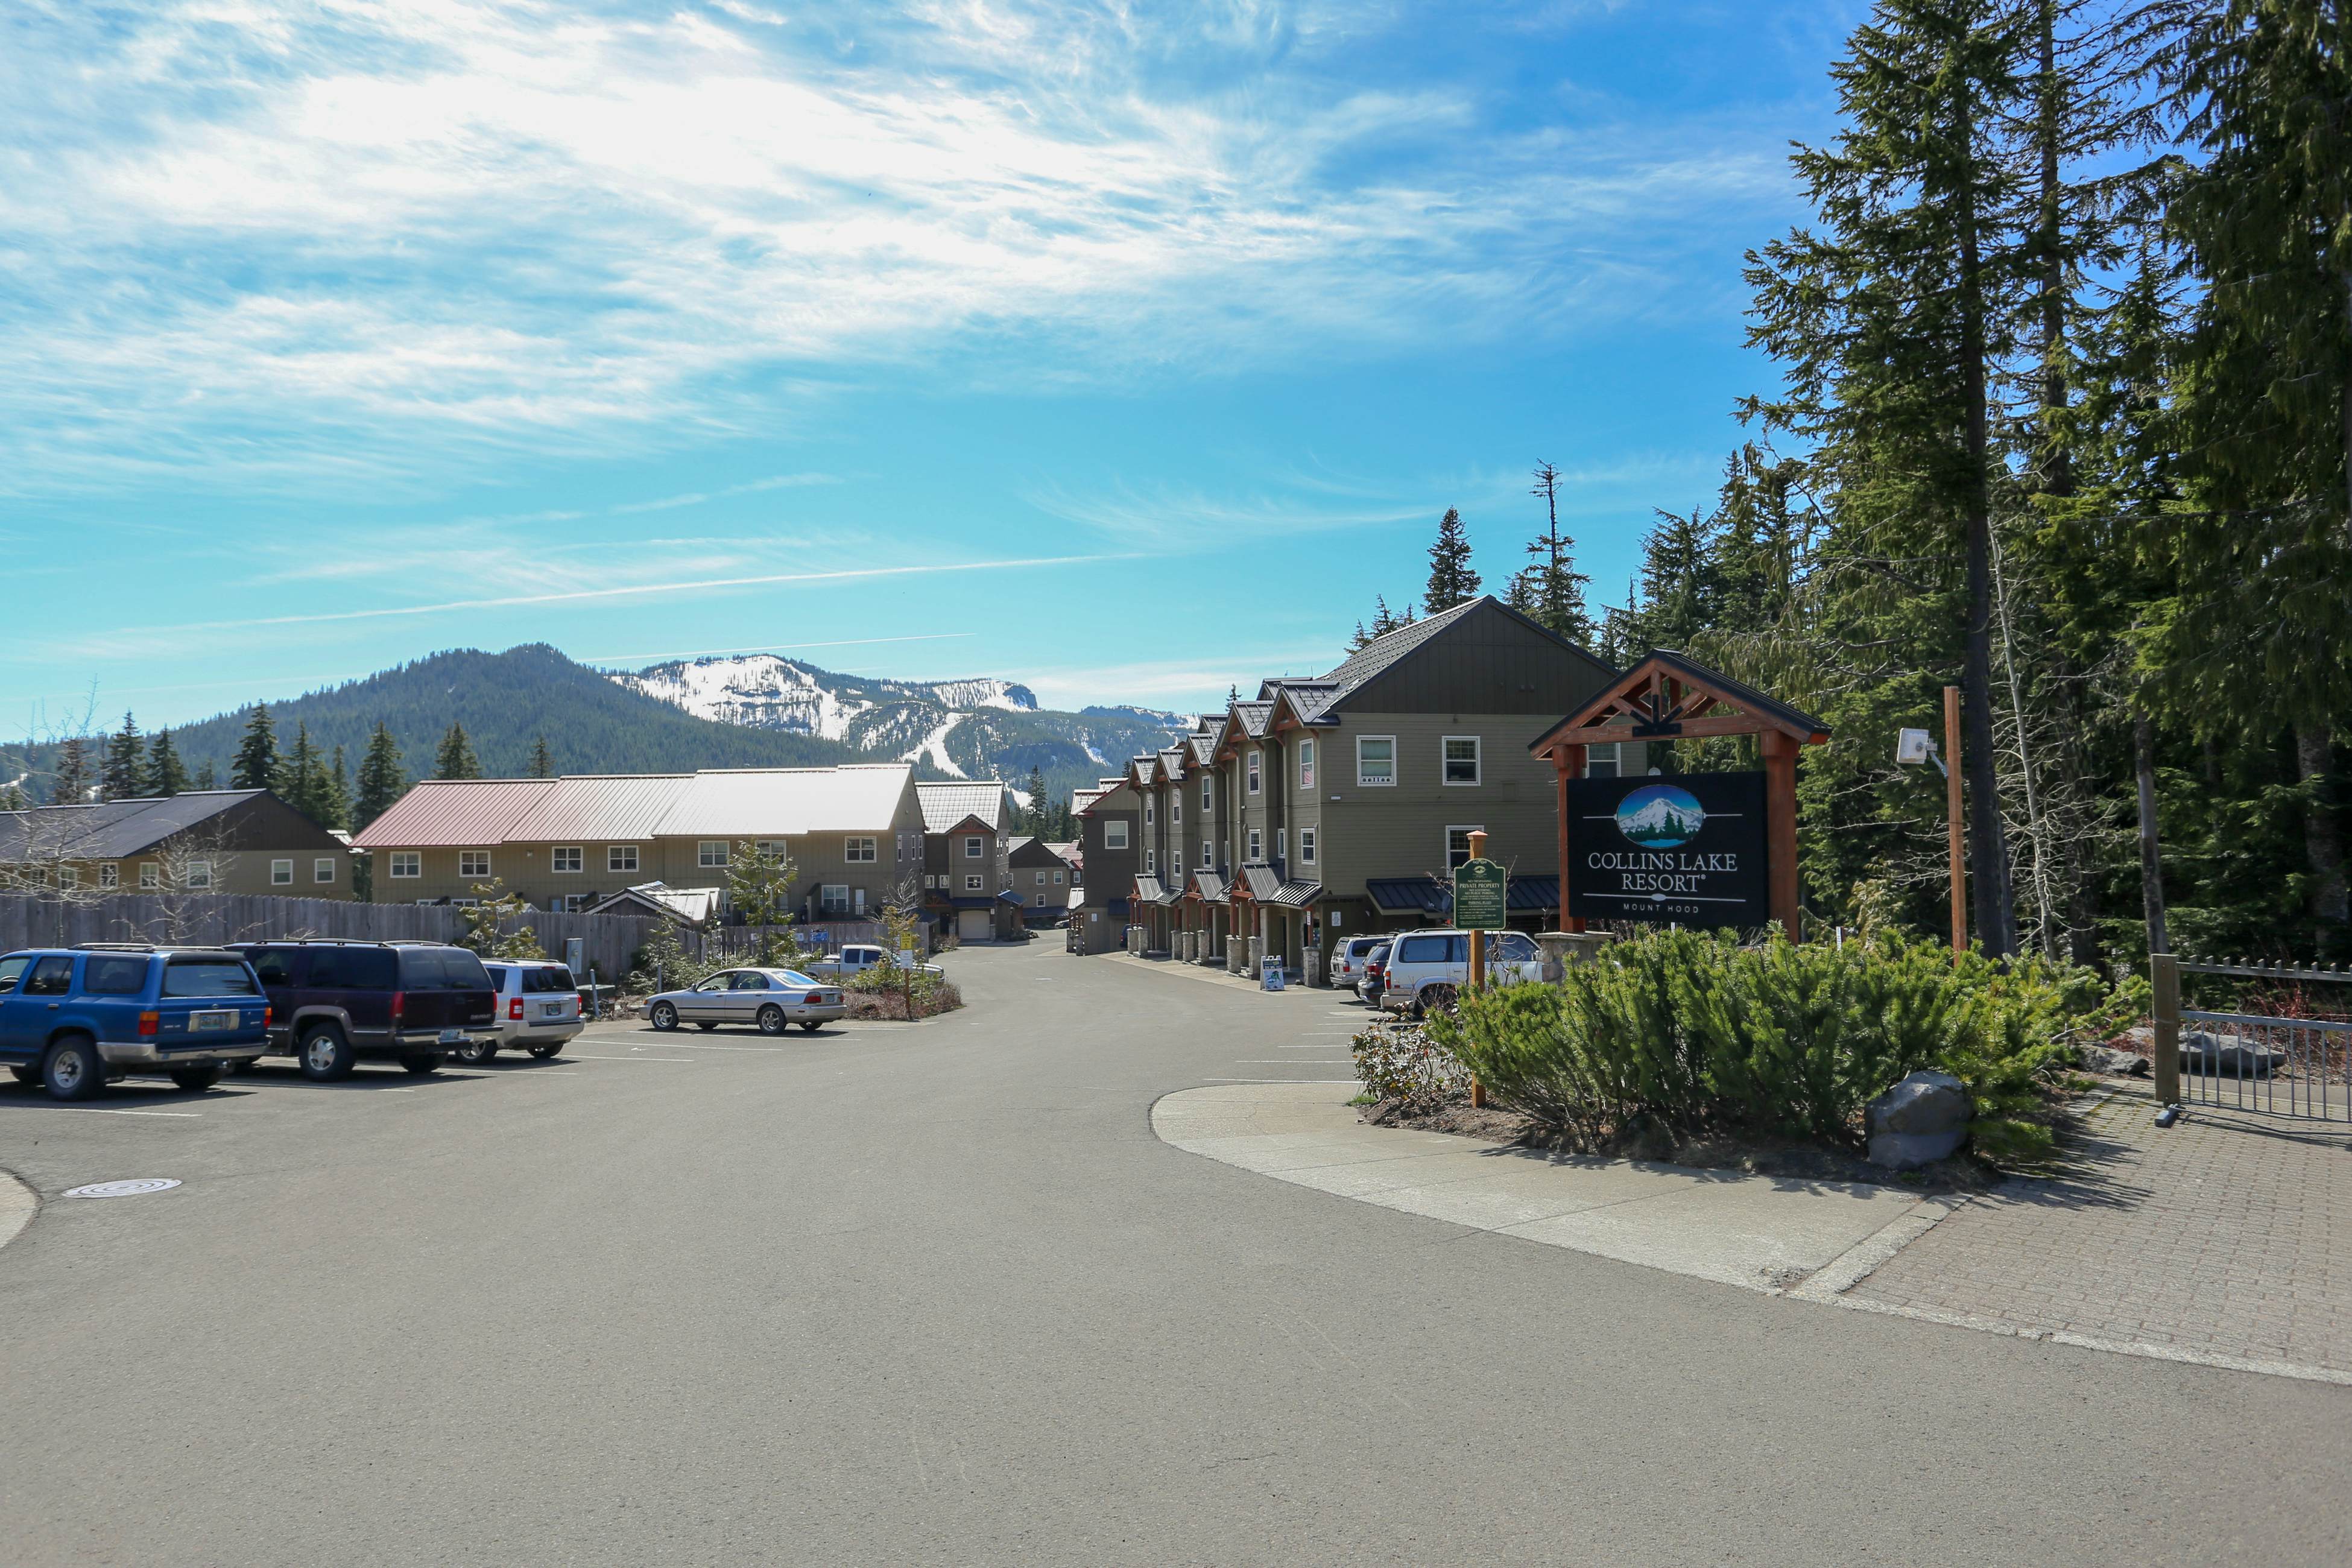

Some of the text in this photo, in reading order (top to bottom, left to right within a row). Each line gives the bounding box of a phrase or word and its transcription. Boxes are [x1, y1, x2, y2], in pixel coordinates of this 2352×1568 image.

[1588, 853, 1737, 871] COLLINS LAKE
[1623, 903, 1660, 912] MOUNT
